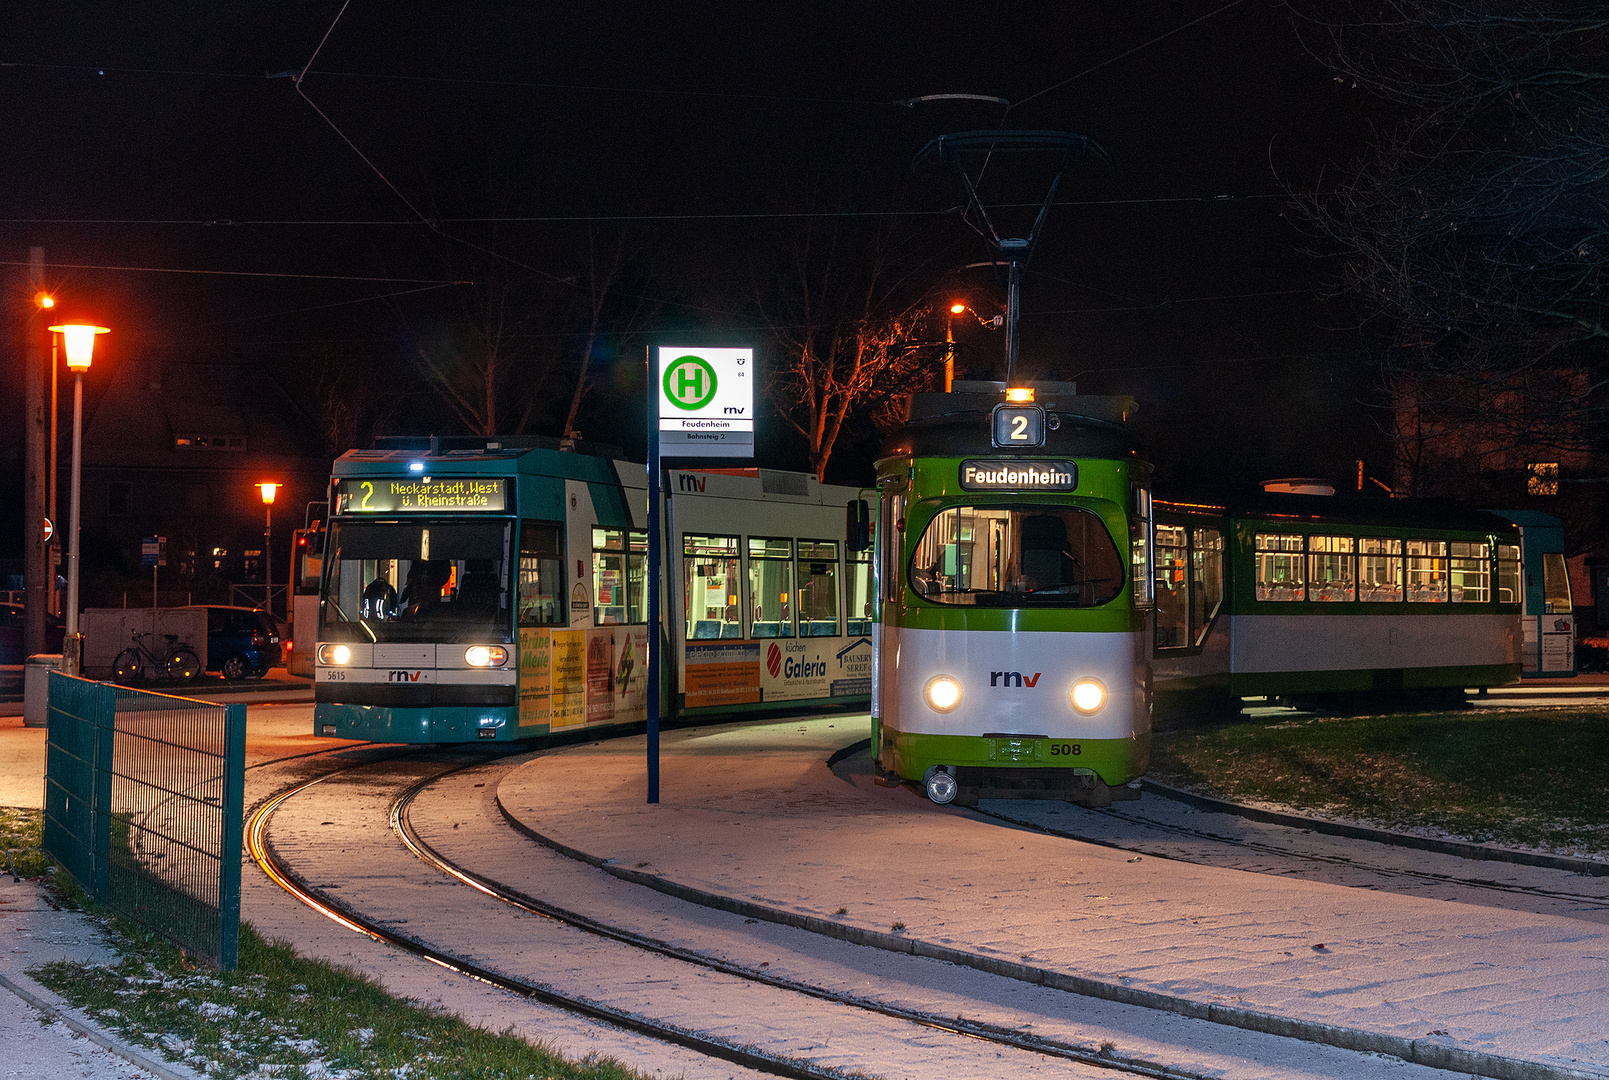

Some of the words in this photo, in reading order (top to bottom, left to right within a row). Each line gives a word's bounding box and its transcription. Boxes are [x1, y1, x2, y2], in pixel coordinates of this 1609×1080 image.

[678, 368, 702, 398] H
[682, 420, 730, 428] Feudenheim
[1010, 415, 1028, 440] 2
[687, 433, 719, 441] Bahnsteig
[965, 467, 1072, 484] Feudenheim
[679, 473, 707, 493] rnv
[360, 481, 375, 511] 2
[402, 495, 413, 507] ü.
[417, 495, 488, 508] Rheinstraße
[690, 645, 716, 659] elektro
[785, 641, 807, 653] küchen
[522, 651, 549, 669] Meile
[784, 654, 827, 679] Galeria
[847, 663, 867, 673] SEREF
[328, 671, 346, 681] 5615
[389, 671, 421, 682] rnv
[990, 671, 1041, 688] rnv
[1050, 744, 1082, 756] 508
